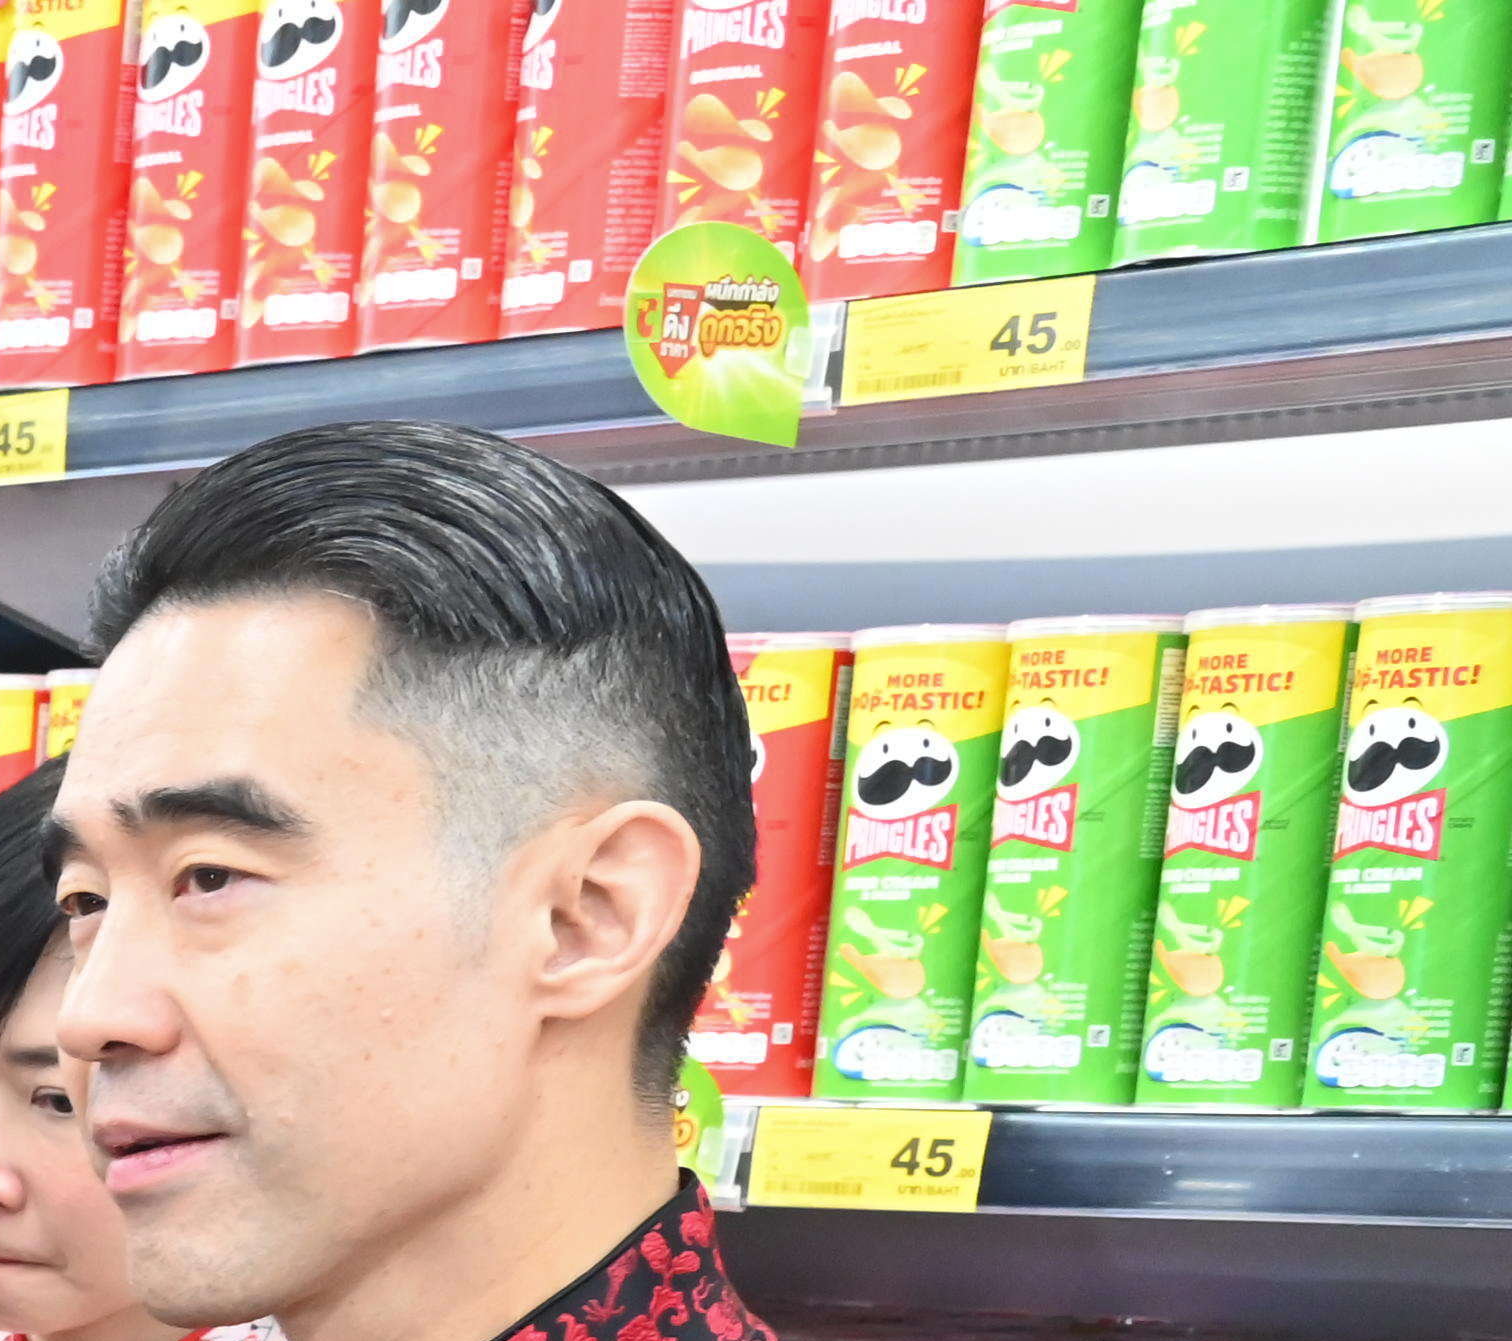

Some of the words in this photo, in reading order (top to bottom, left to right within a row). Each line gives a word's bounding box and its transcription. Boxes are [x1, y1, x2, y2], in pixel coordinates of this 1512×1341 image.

[1020, 650, 1065, 666] MORE
[1198, 653, 1248, 670] MORE
[1376, 646, 1433, 665] MORE
[887, 672, 944, 688] MORE
[845, 811, 951, 864] PRINGLES
